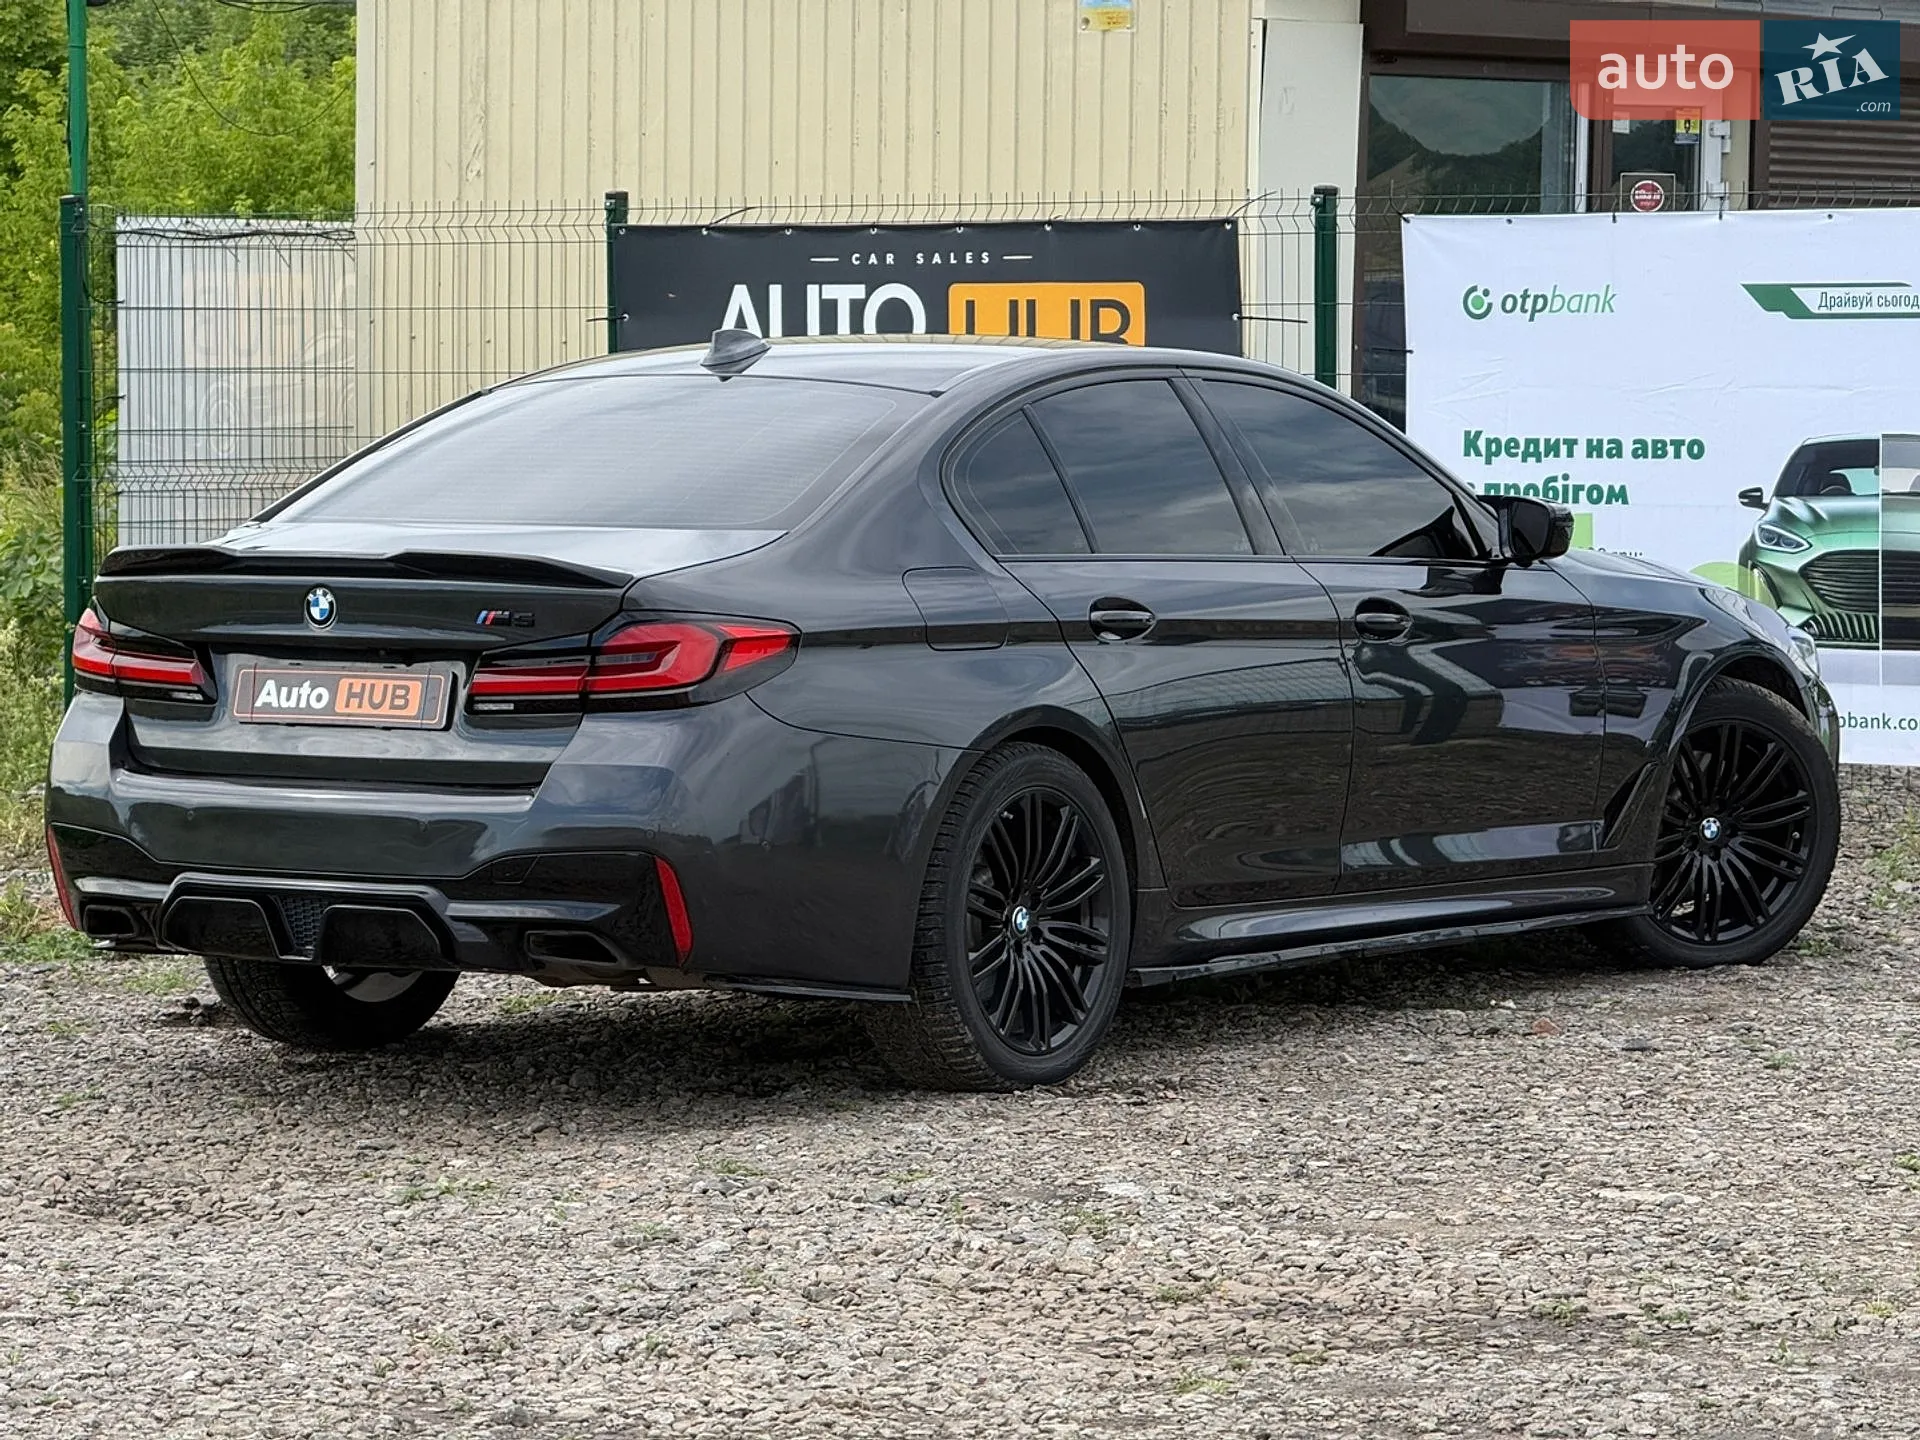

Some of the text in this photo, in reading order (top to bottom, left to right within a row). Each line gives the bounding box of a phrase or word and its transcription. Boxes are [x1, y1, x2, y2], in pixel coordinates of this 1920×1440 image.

[851, 251, 991, 266] CAR SALES
[1500, 284, 1617, 322] otpbank
[1817, 291, 1873, 311] Драйвуй
[1463, 430, 1706, 465] Кредит на авто
[254, 679, 411, 711] Auto HUB
[1838, 711, 1920, 731] bank.co
